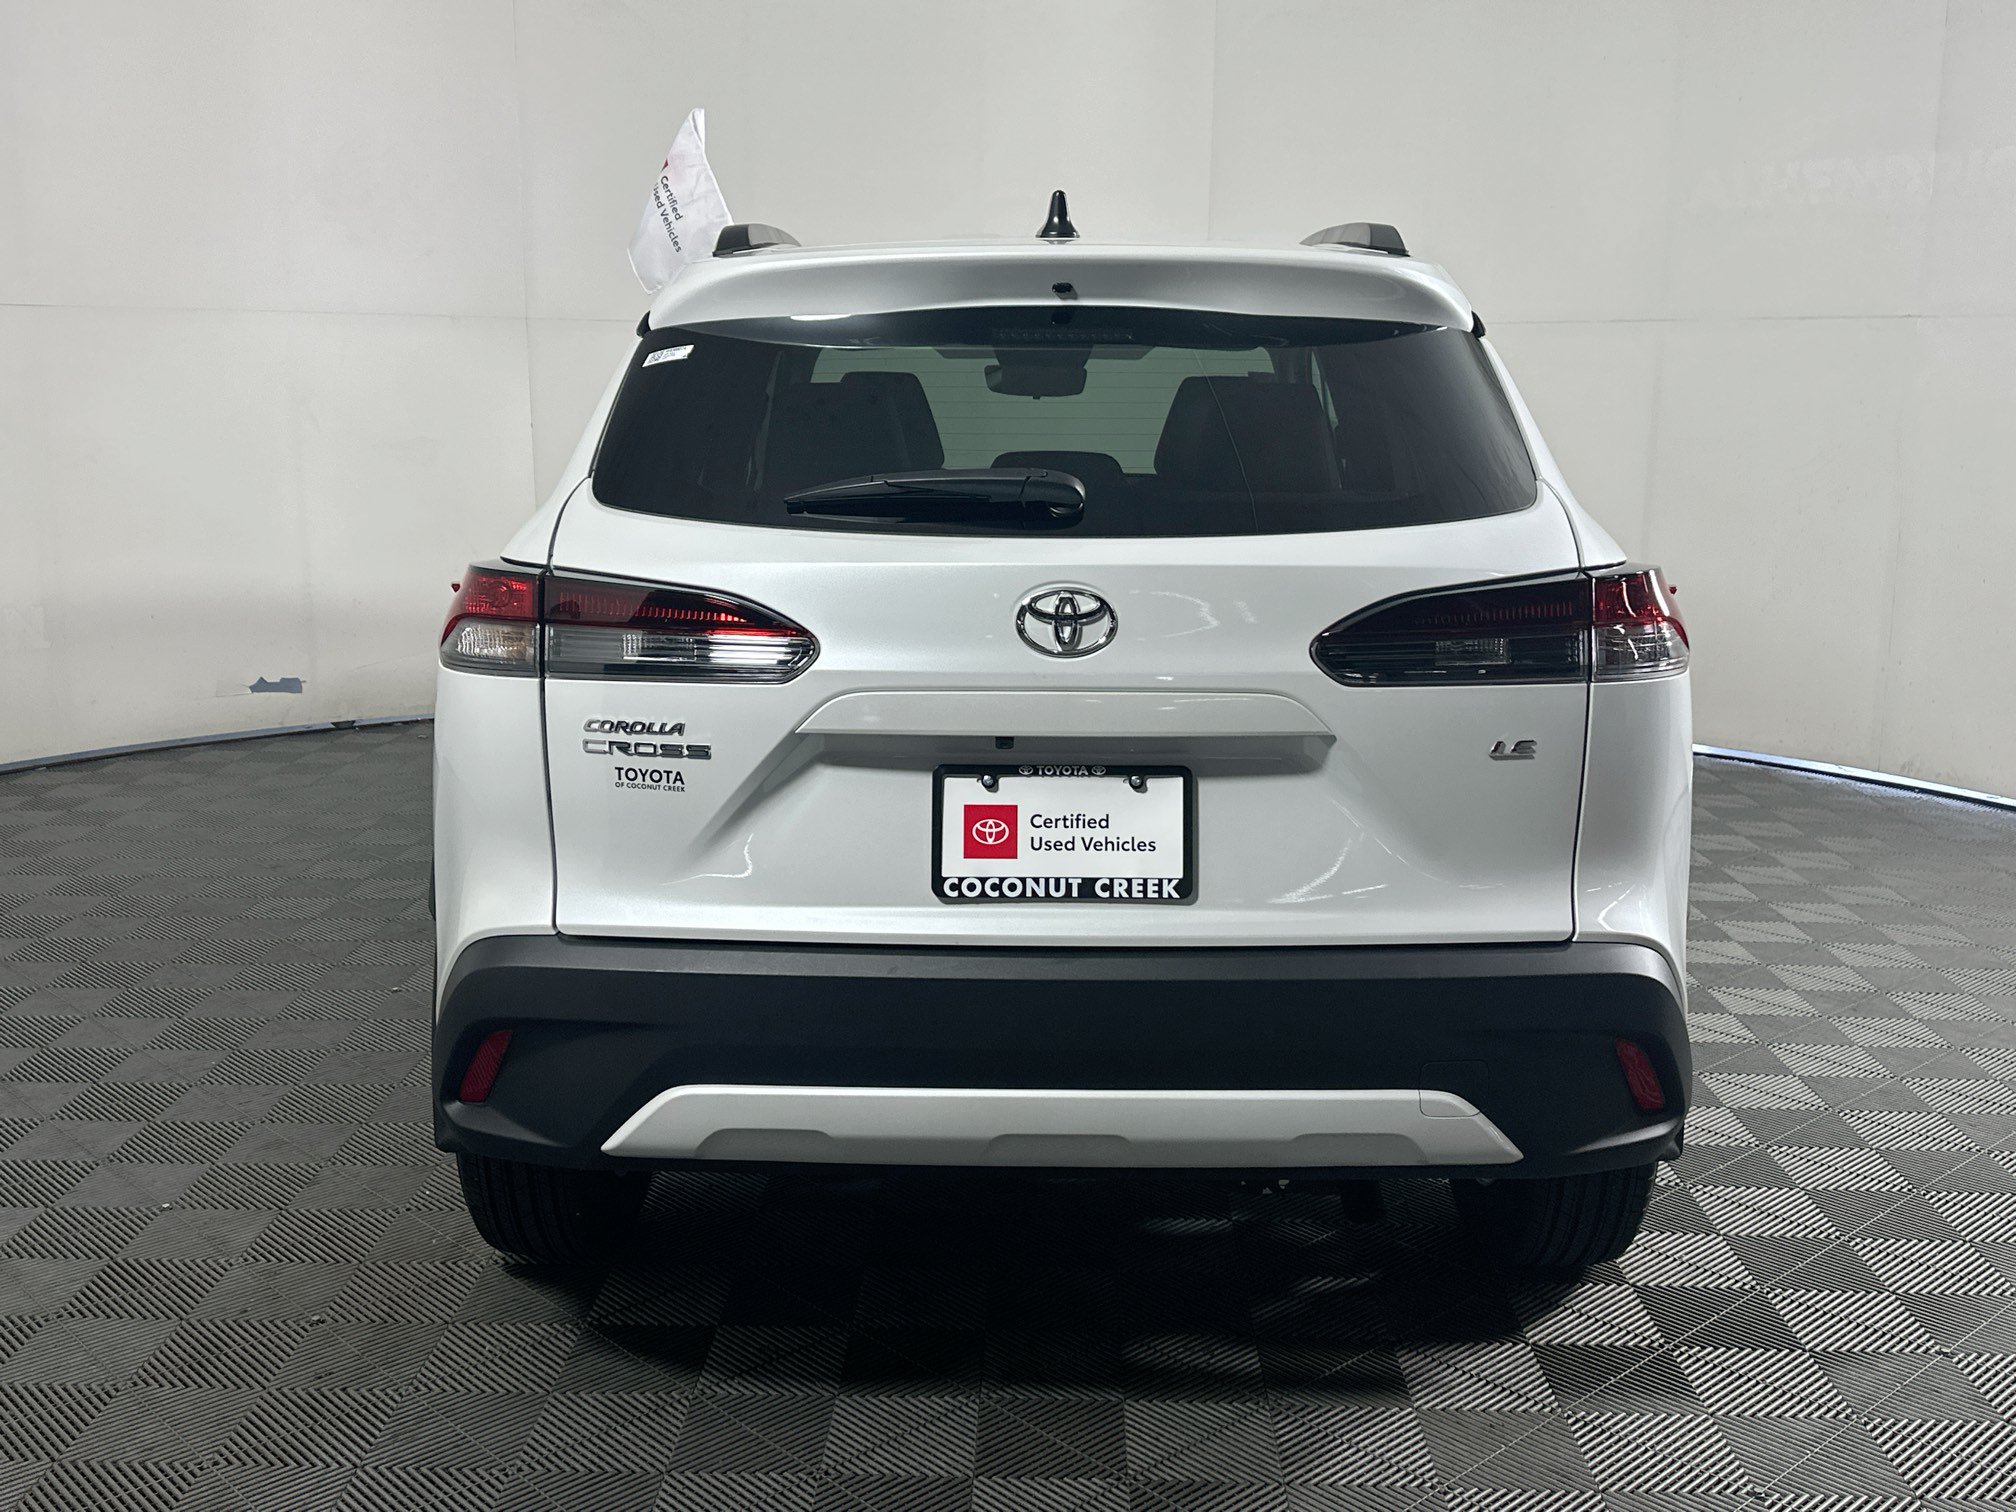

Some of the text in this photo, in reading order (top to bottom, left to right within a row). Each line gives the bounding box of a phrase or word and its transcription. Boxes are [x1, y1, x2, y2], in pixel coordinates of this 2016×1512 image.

[660, 175, 683, 221] Certified
[661, 208, 681, 252] Vehicles
[583, 719, 685, 736] COROLLA
[583, 739, 711, 760] CROSS
[1488, 740, 1537, 761] LE
[615, 767, 685, 785] TOYOTA
[1036, 765, 1088, 776] TOYOTA
[626, 782, 661, 791] COCONUT
[662, 784, 686, 793] CREEK
[1030, 814, 1110, 830] Certified
[1030, 836, 1157, 852] Used Vehicles
[943, 877, 1180, 899] COCONUT CREEK
